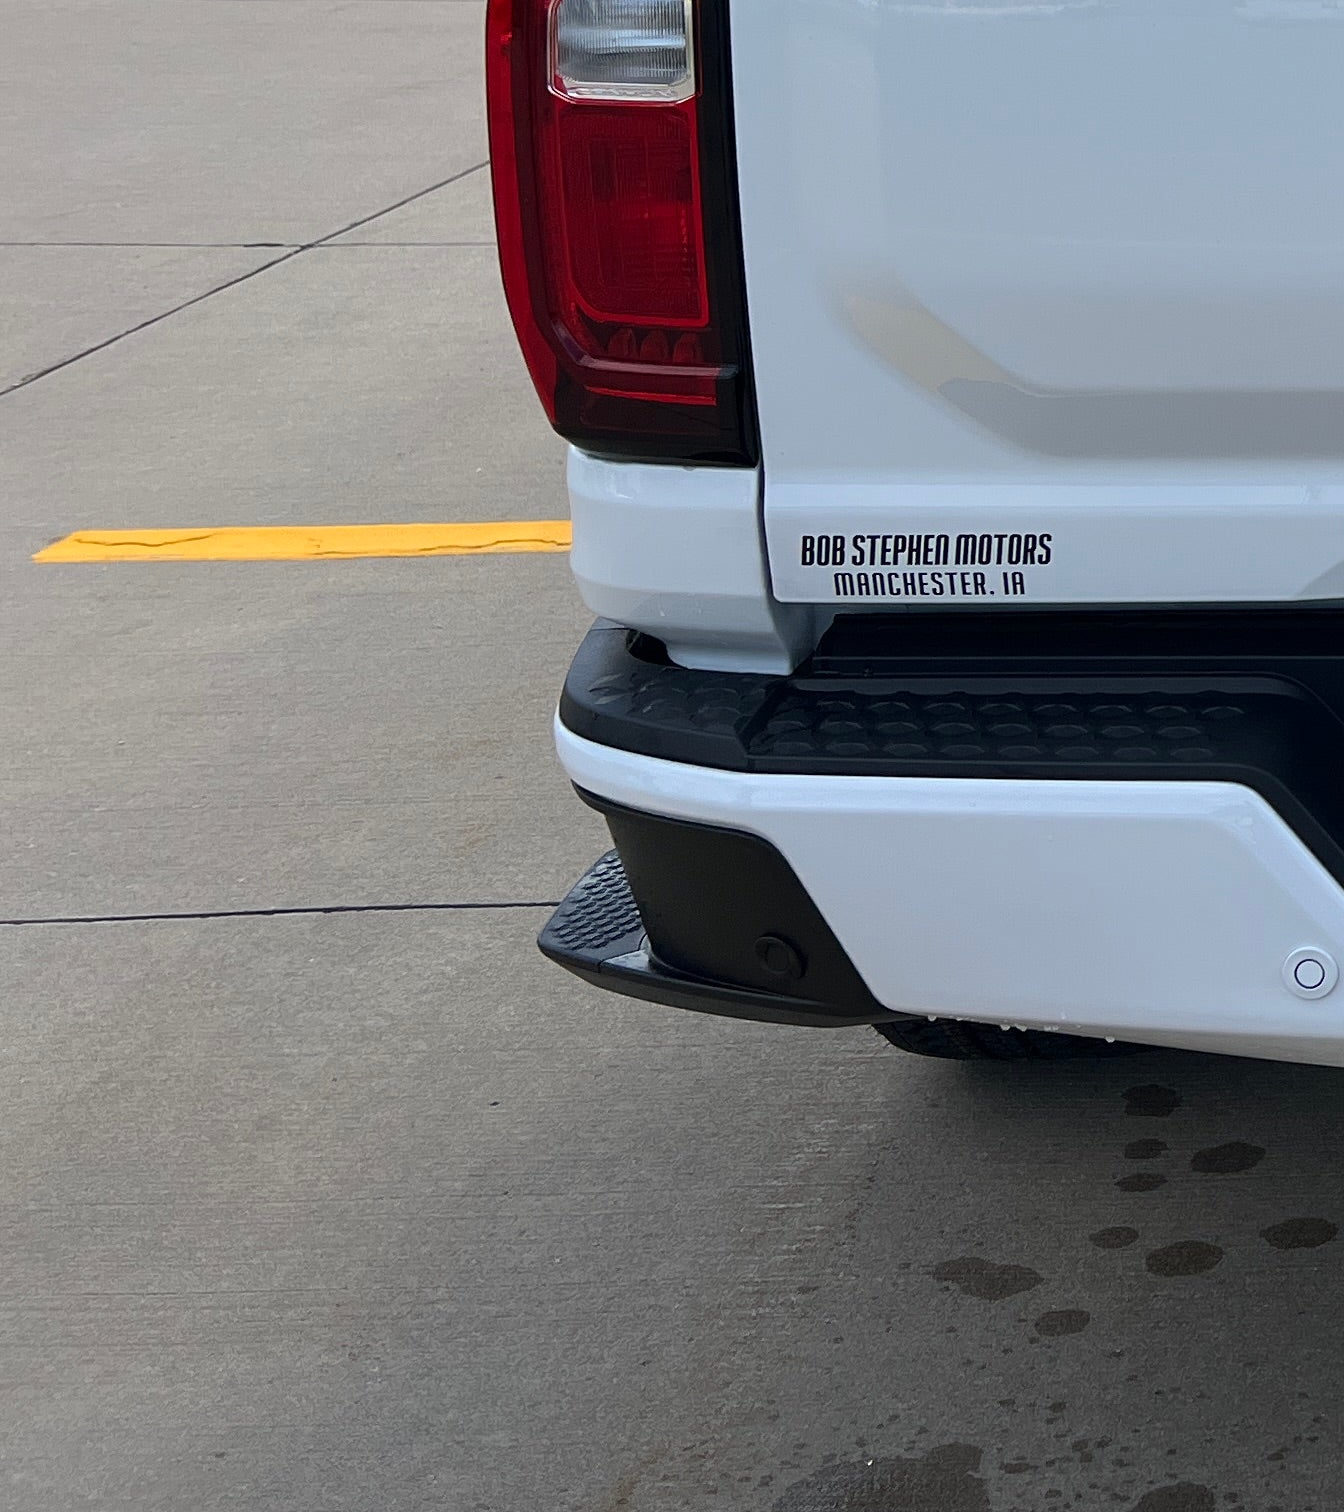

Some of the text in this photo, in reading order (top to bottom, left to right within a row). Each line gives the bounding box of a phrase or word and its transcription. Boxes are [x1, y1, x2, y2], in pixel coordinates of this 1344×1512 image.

[801, 533, 1053, 566] BOB STEPHEN MOTORS
[1002, 571, 1026, 595] IA
